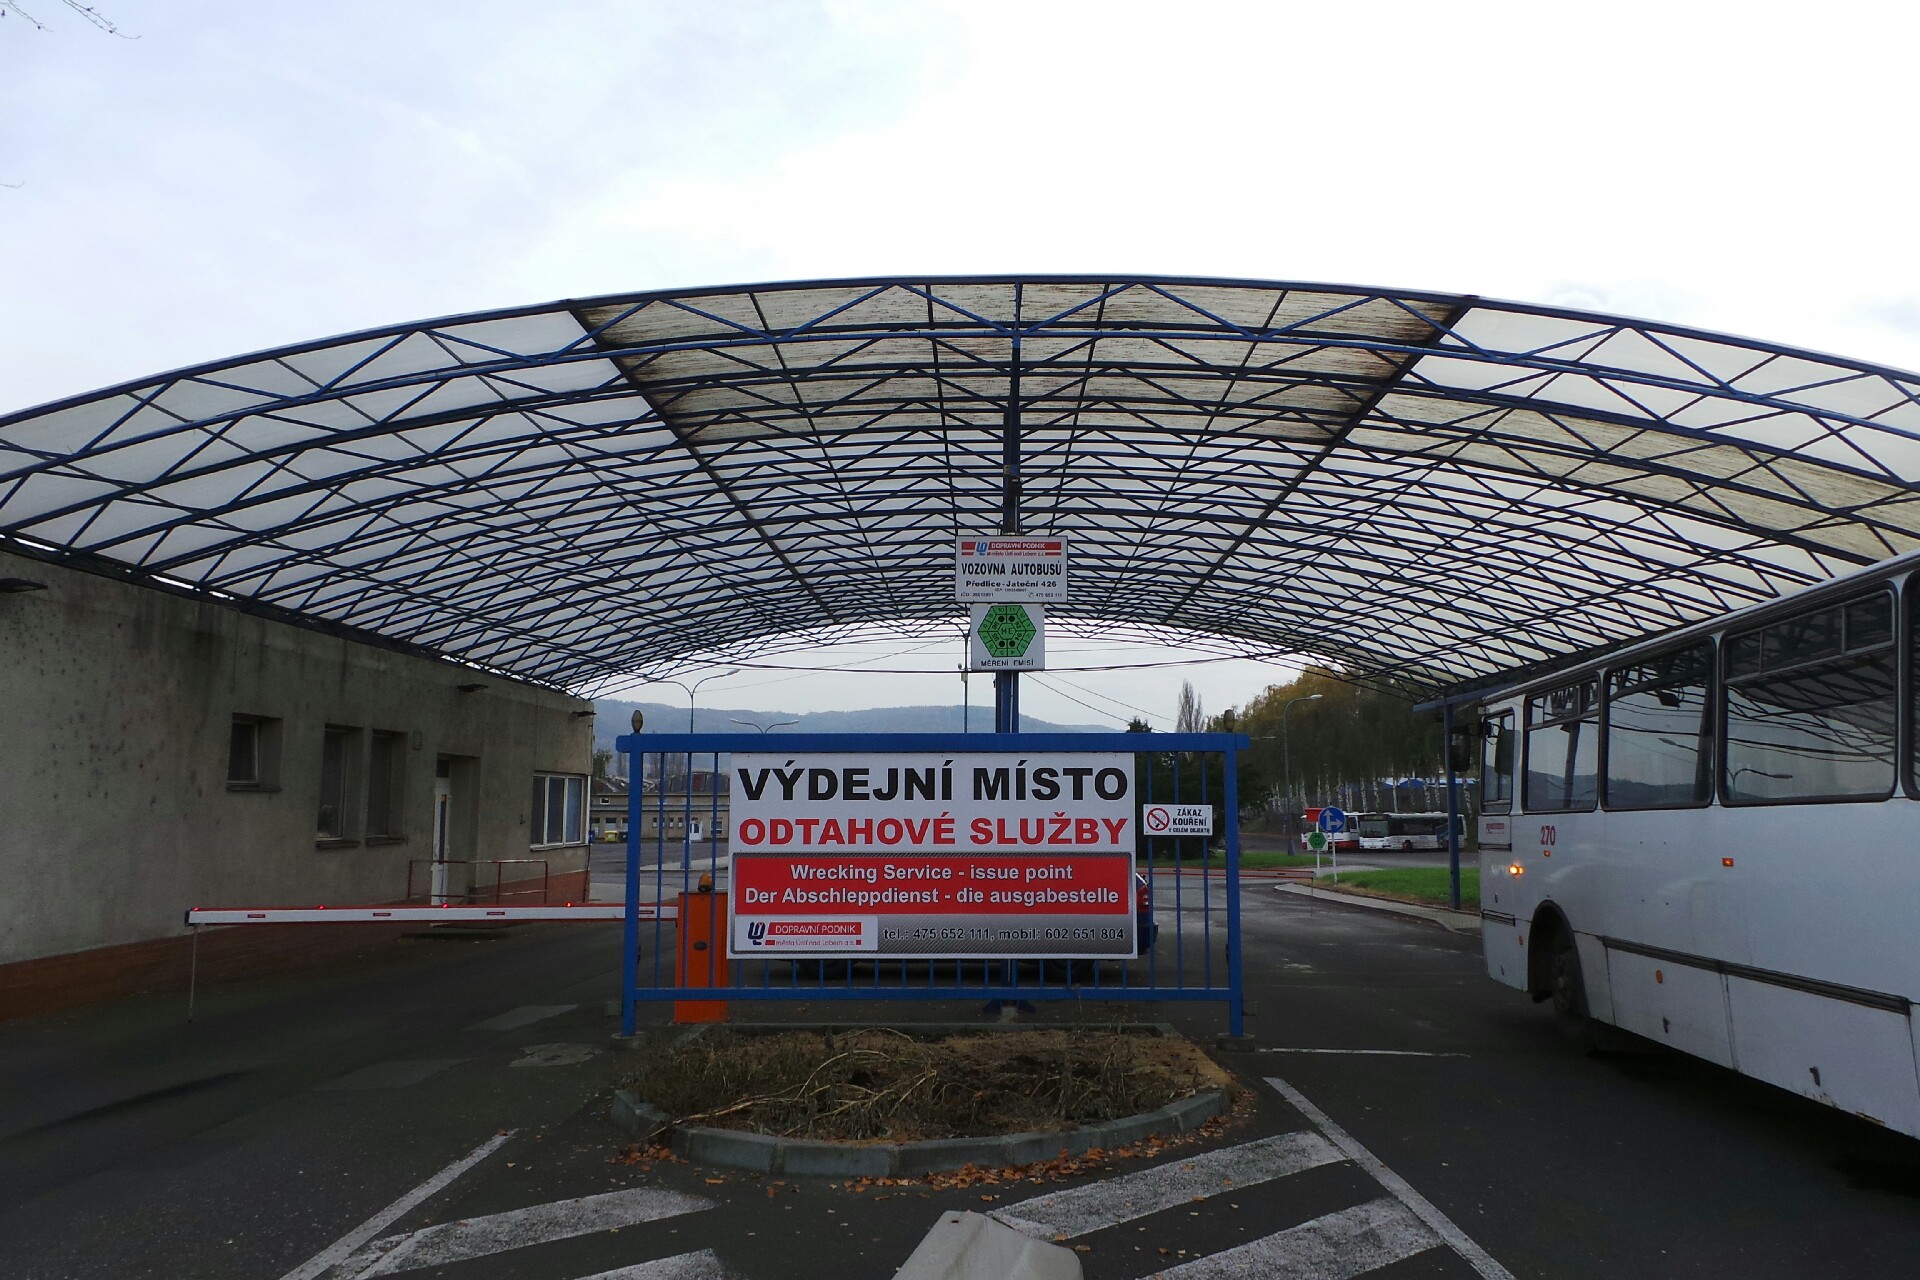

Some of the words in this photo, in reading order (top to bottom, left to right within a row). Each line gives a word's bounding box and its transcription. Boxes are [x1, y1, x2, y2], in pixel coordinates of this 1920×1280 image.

[961, 563, 1006, 575] VOZOVNA
[737, 760, 953, 801] VÝDEJNÍ
[973, 760, 1128, 801] MÍSTO
[1177, 807, 1202, 817] ZÁKAZ
[739, 812, 956, 845] ODTAHOVÉ
[969, 812, 1128, 845] SLUŽBY
[1172, 817, 1208, 826] KOUŘENÍ
[1540, 825, 1556, 846] 270
[791, 865, 877, 883] Wrecking
[883, 865, 952, 880] Service
[970, 865, 1019, 880] issue
[1025, 865, 1073, 883] point
[745, 888, 777, 903] Der
[782, 888, 939, 906] Abschleppdienst
[956, 888, 984, 903] die
[990, 888, 1119, 907] ausgabestelle
[775, 924, 820, 933] DOPRAVNÍ
[821, 925, 856, 933] PODNIK
[883, 928, 909, 939] tel.:
[912, 928, 937, 940] 475
[940, 928, 964, 940] 652
[969, 928, 994, 941] 111,
[998, 928, 1040, 940] mobil:
[1045, 928, 1069, 940] 602
[1073, 928, 1096, 940] 651
[1100, 928, 1124, 940] 804
